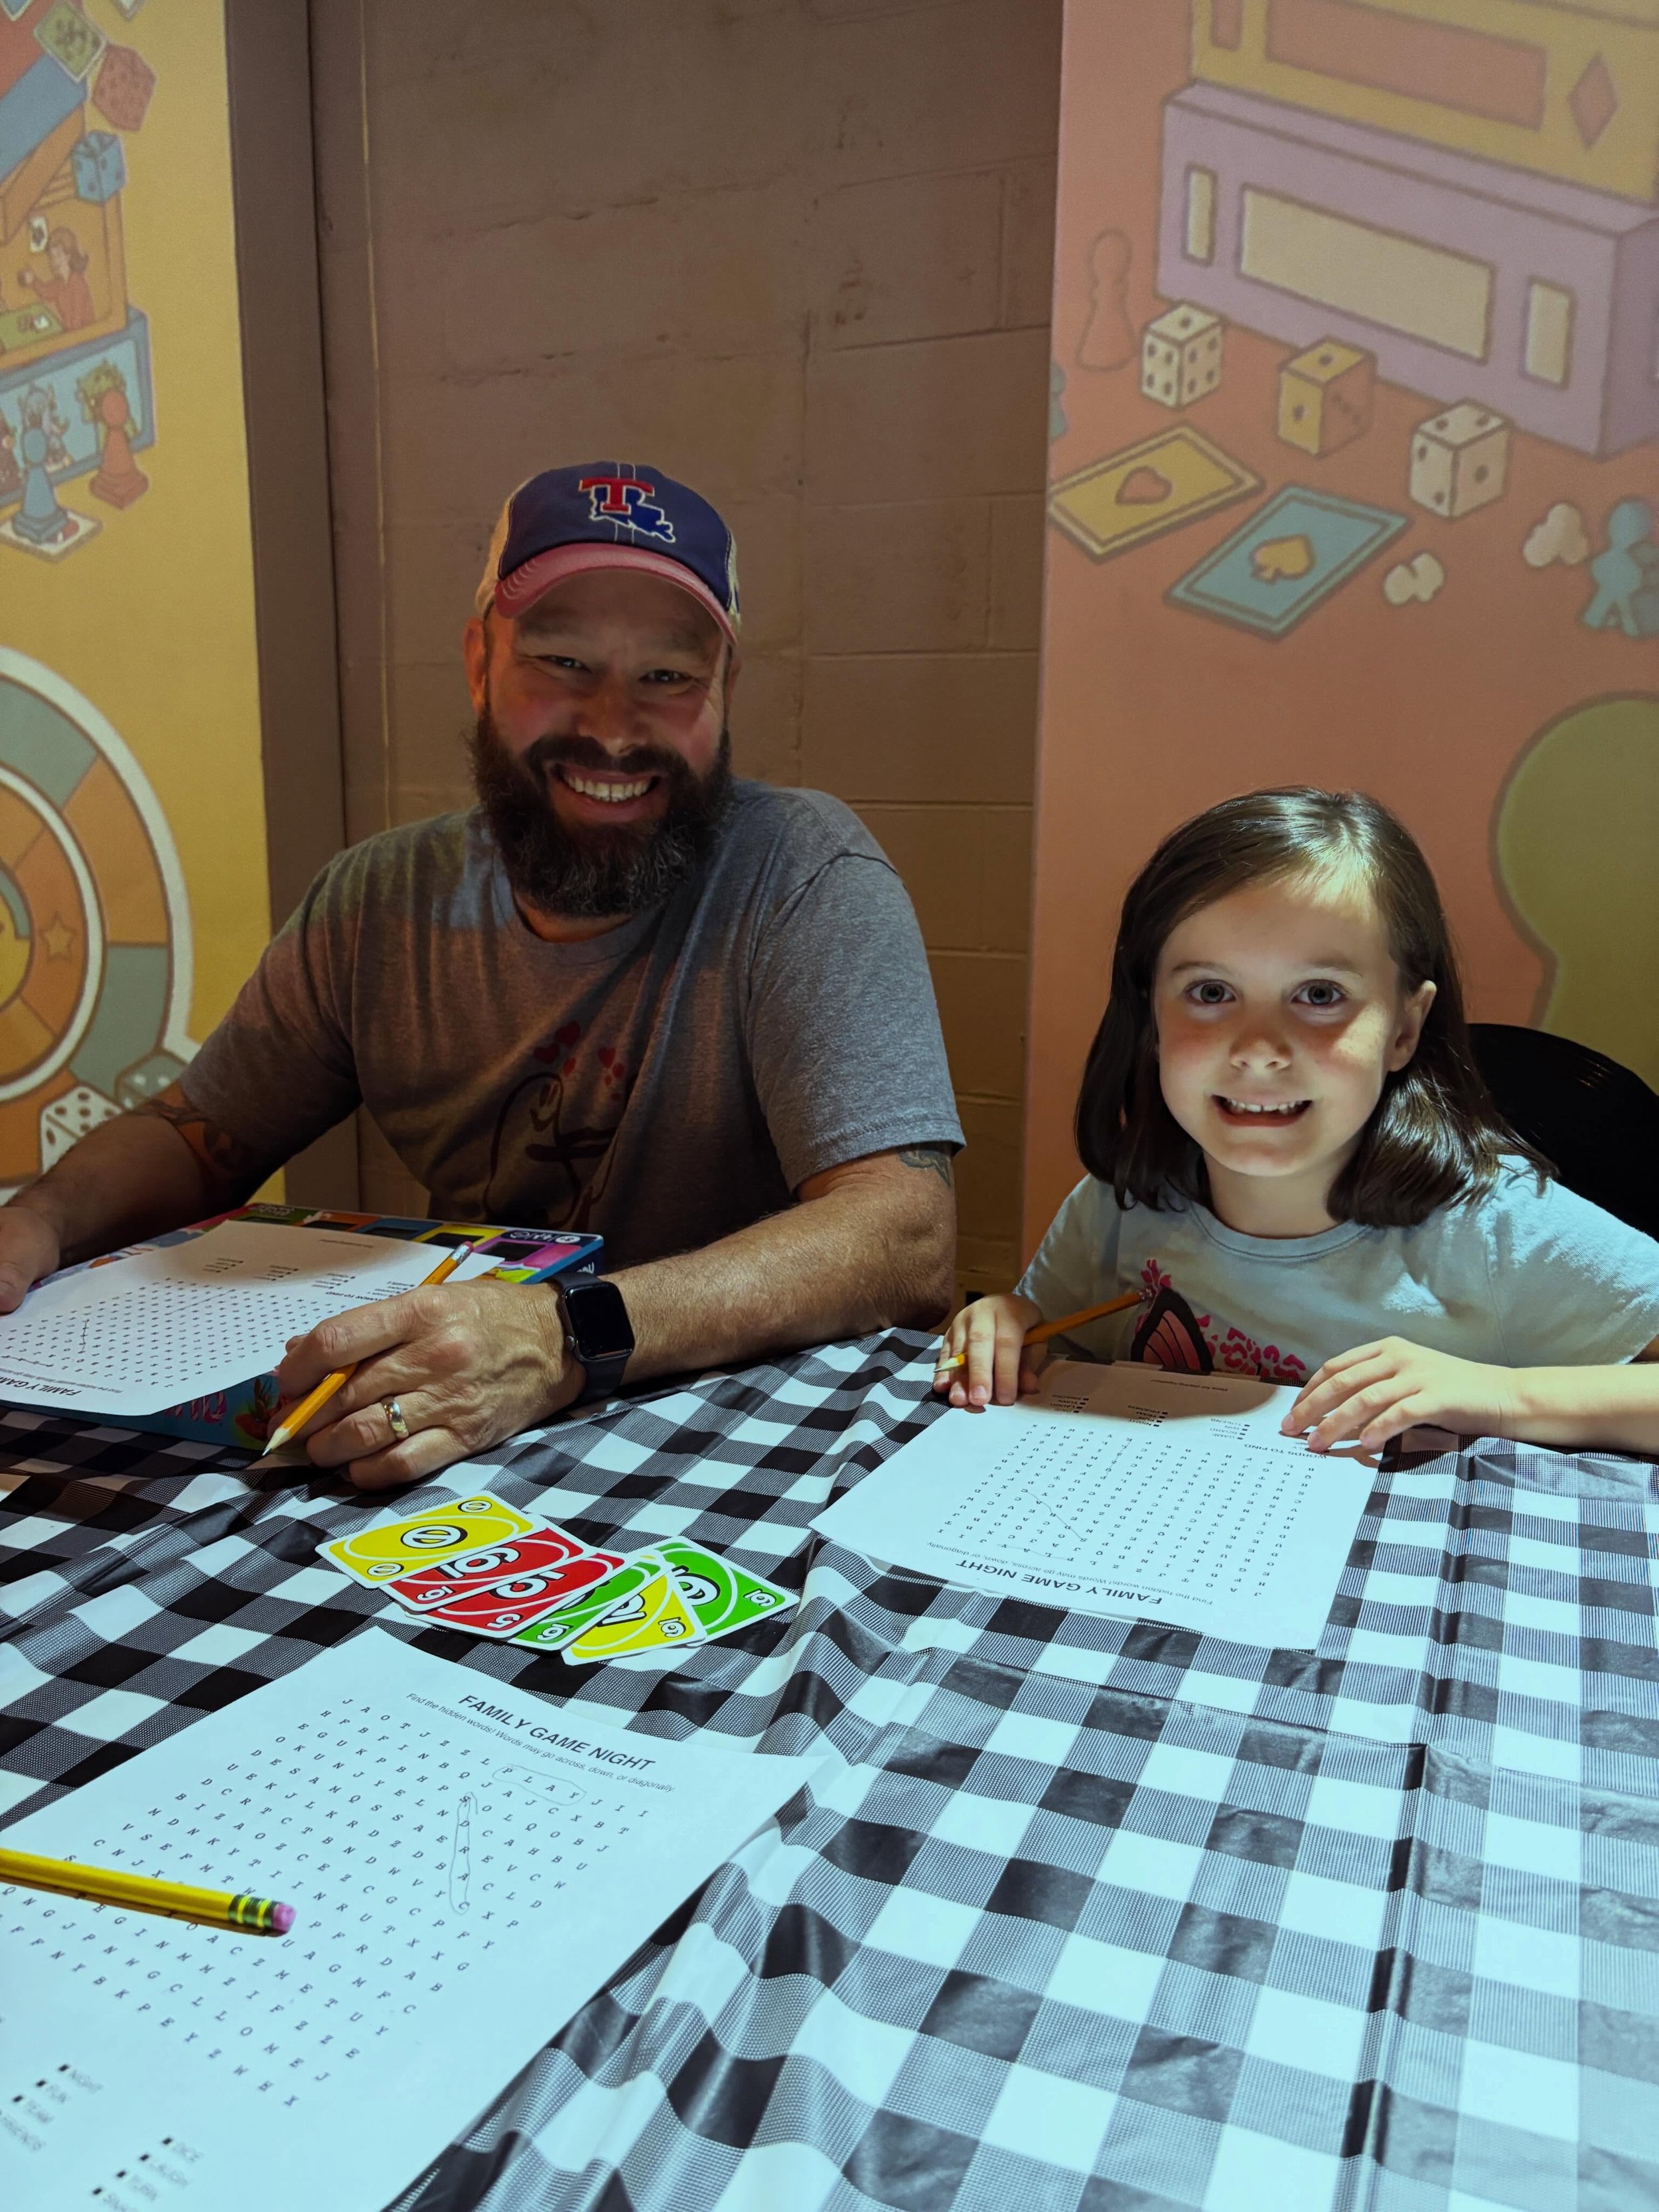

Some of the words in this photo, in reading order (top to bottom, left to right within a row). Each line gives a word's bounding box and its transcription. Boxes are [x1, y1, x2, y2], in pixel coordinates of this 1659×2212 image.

[0, 1375, 29, 1388] GAM
[25, 1383, 82, 1396] FAMILY
[983, 1555, 1008, 1565] down,
[1011, 1561, 1041, 1572] across,
[956, 1560, 1017, 1578] NIGHT
[1021, 1574, 1080, 1591] GAME
[1078, 1576, 1106, 1584] Words
[1086, 1587, 1163, 1605] FAMILY
[1142, 1586, 1173, 1596] hidden
[485, 1613, 524, 1629] 5
[458, 1695, 531, 1729] FAMILY
[530, 1727, 591, 1753] GAME
[588, 1747, 656, 1771] NIGHT
[407, 1693, 425, 1705] Find
[423, 1699, 440, 1710] the
[438, 1705, 467, 1721] hidden
[467, 1718, 496, 1733] words!
[495, 1730, 522, 1747] Words
[522, 1743, 543, 1757] may
[542, 1752, 555, 1761] go
[555, 1755, 587, 1771] across,
[588, 1765, 614, 1779] down,
[628, 1777, 676, 1794] diagonally.
